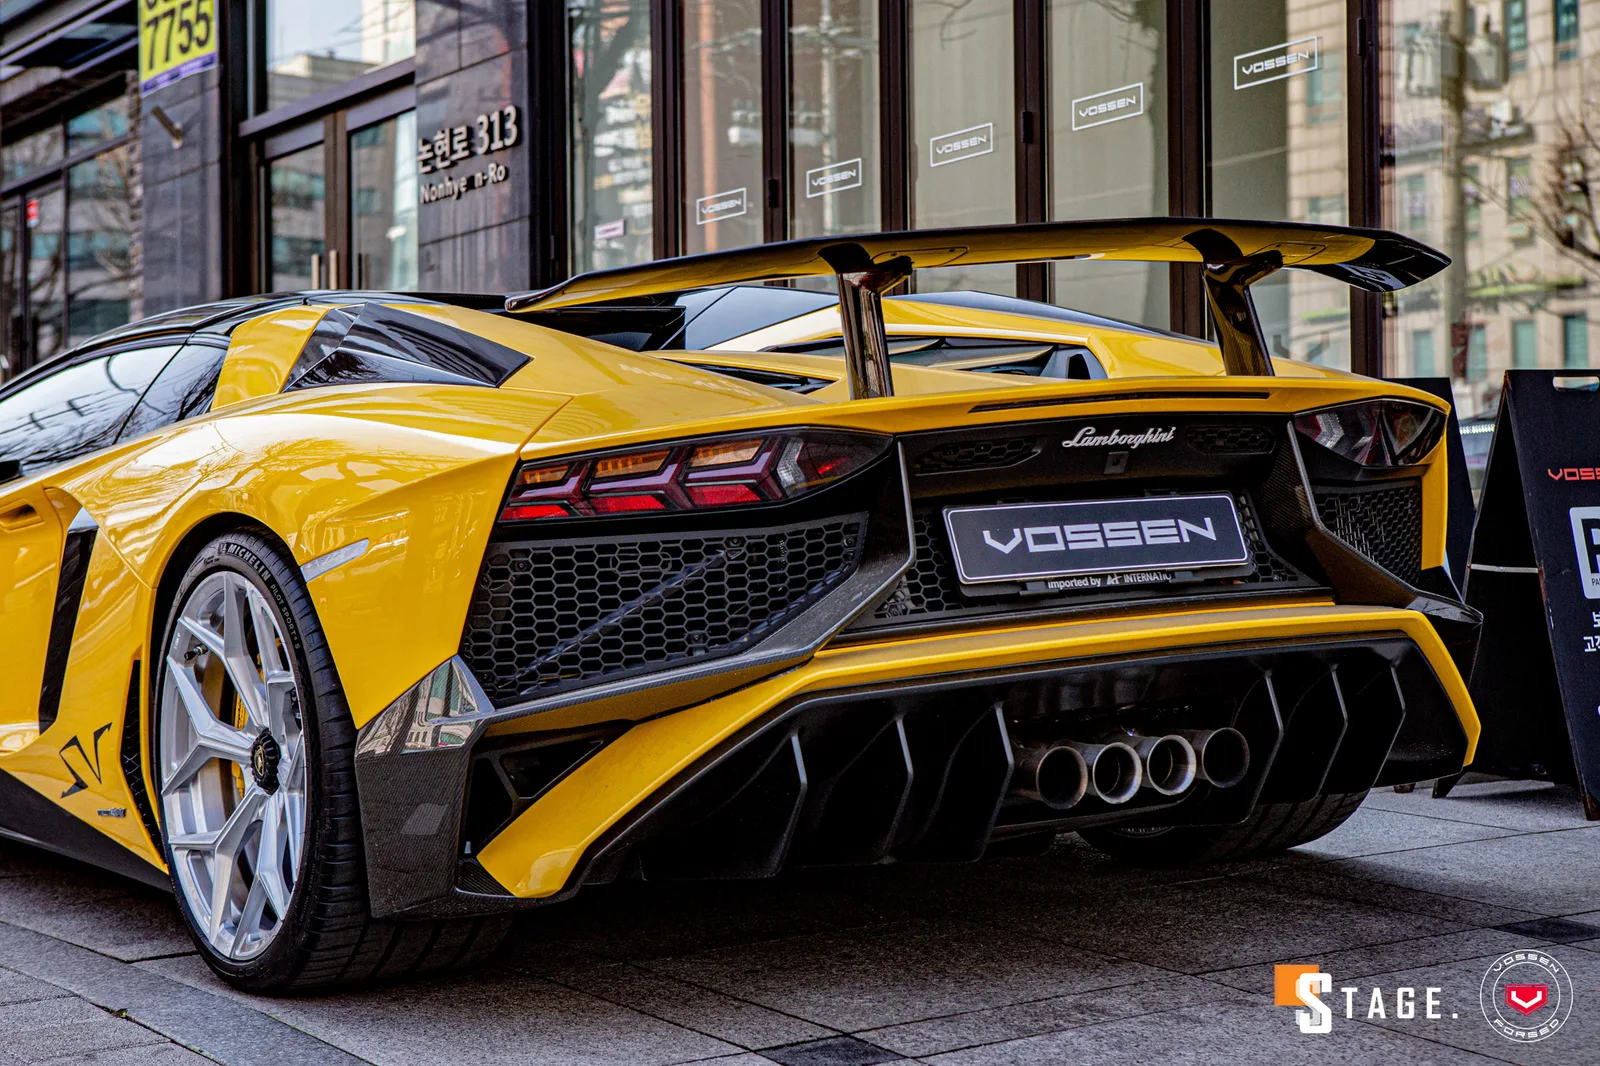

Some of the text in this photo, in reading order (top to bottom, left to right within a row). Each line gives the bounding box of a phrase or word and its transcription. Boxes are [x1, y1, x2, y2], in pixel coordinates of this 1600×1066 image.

[145, 0, 211, 70] 7755
[1241, 50, 1309, 75] VOSSEN
[1078, 95, 1136, 118] VOSSEN
[417, 105, 518, 174] 논현로 313
[936, 134, 987, 154] VOSSEN
[811, 169, 856, 187] VOSSEN
[701, 198, 742, 215] VOSSEN
[1062, 426, 1177, 449] Lamborghini
[982, 517, 1217, 555] VOSSEN
[227, 543, 272, 582] MICHELIN
[270, 584, 285, 605] PILOT
[1090, 576, 1101, 588] by
